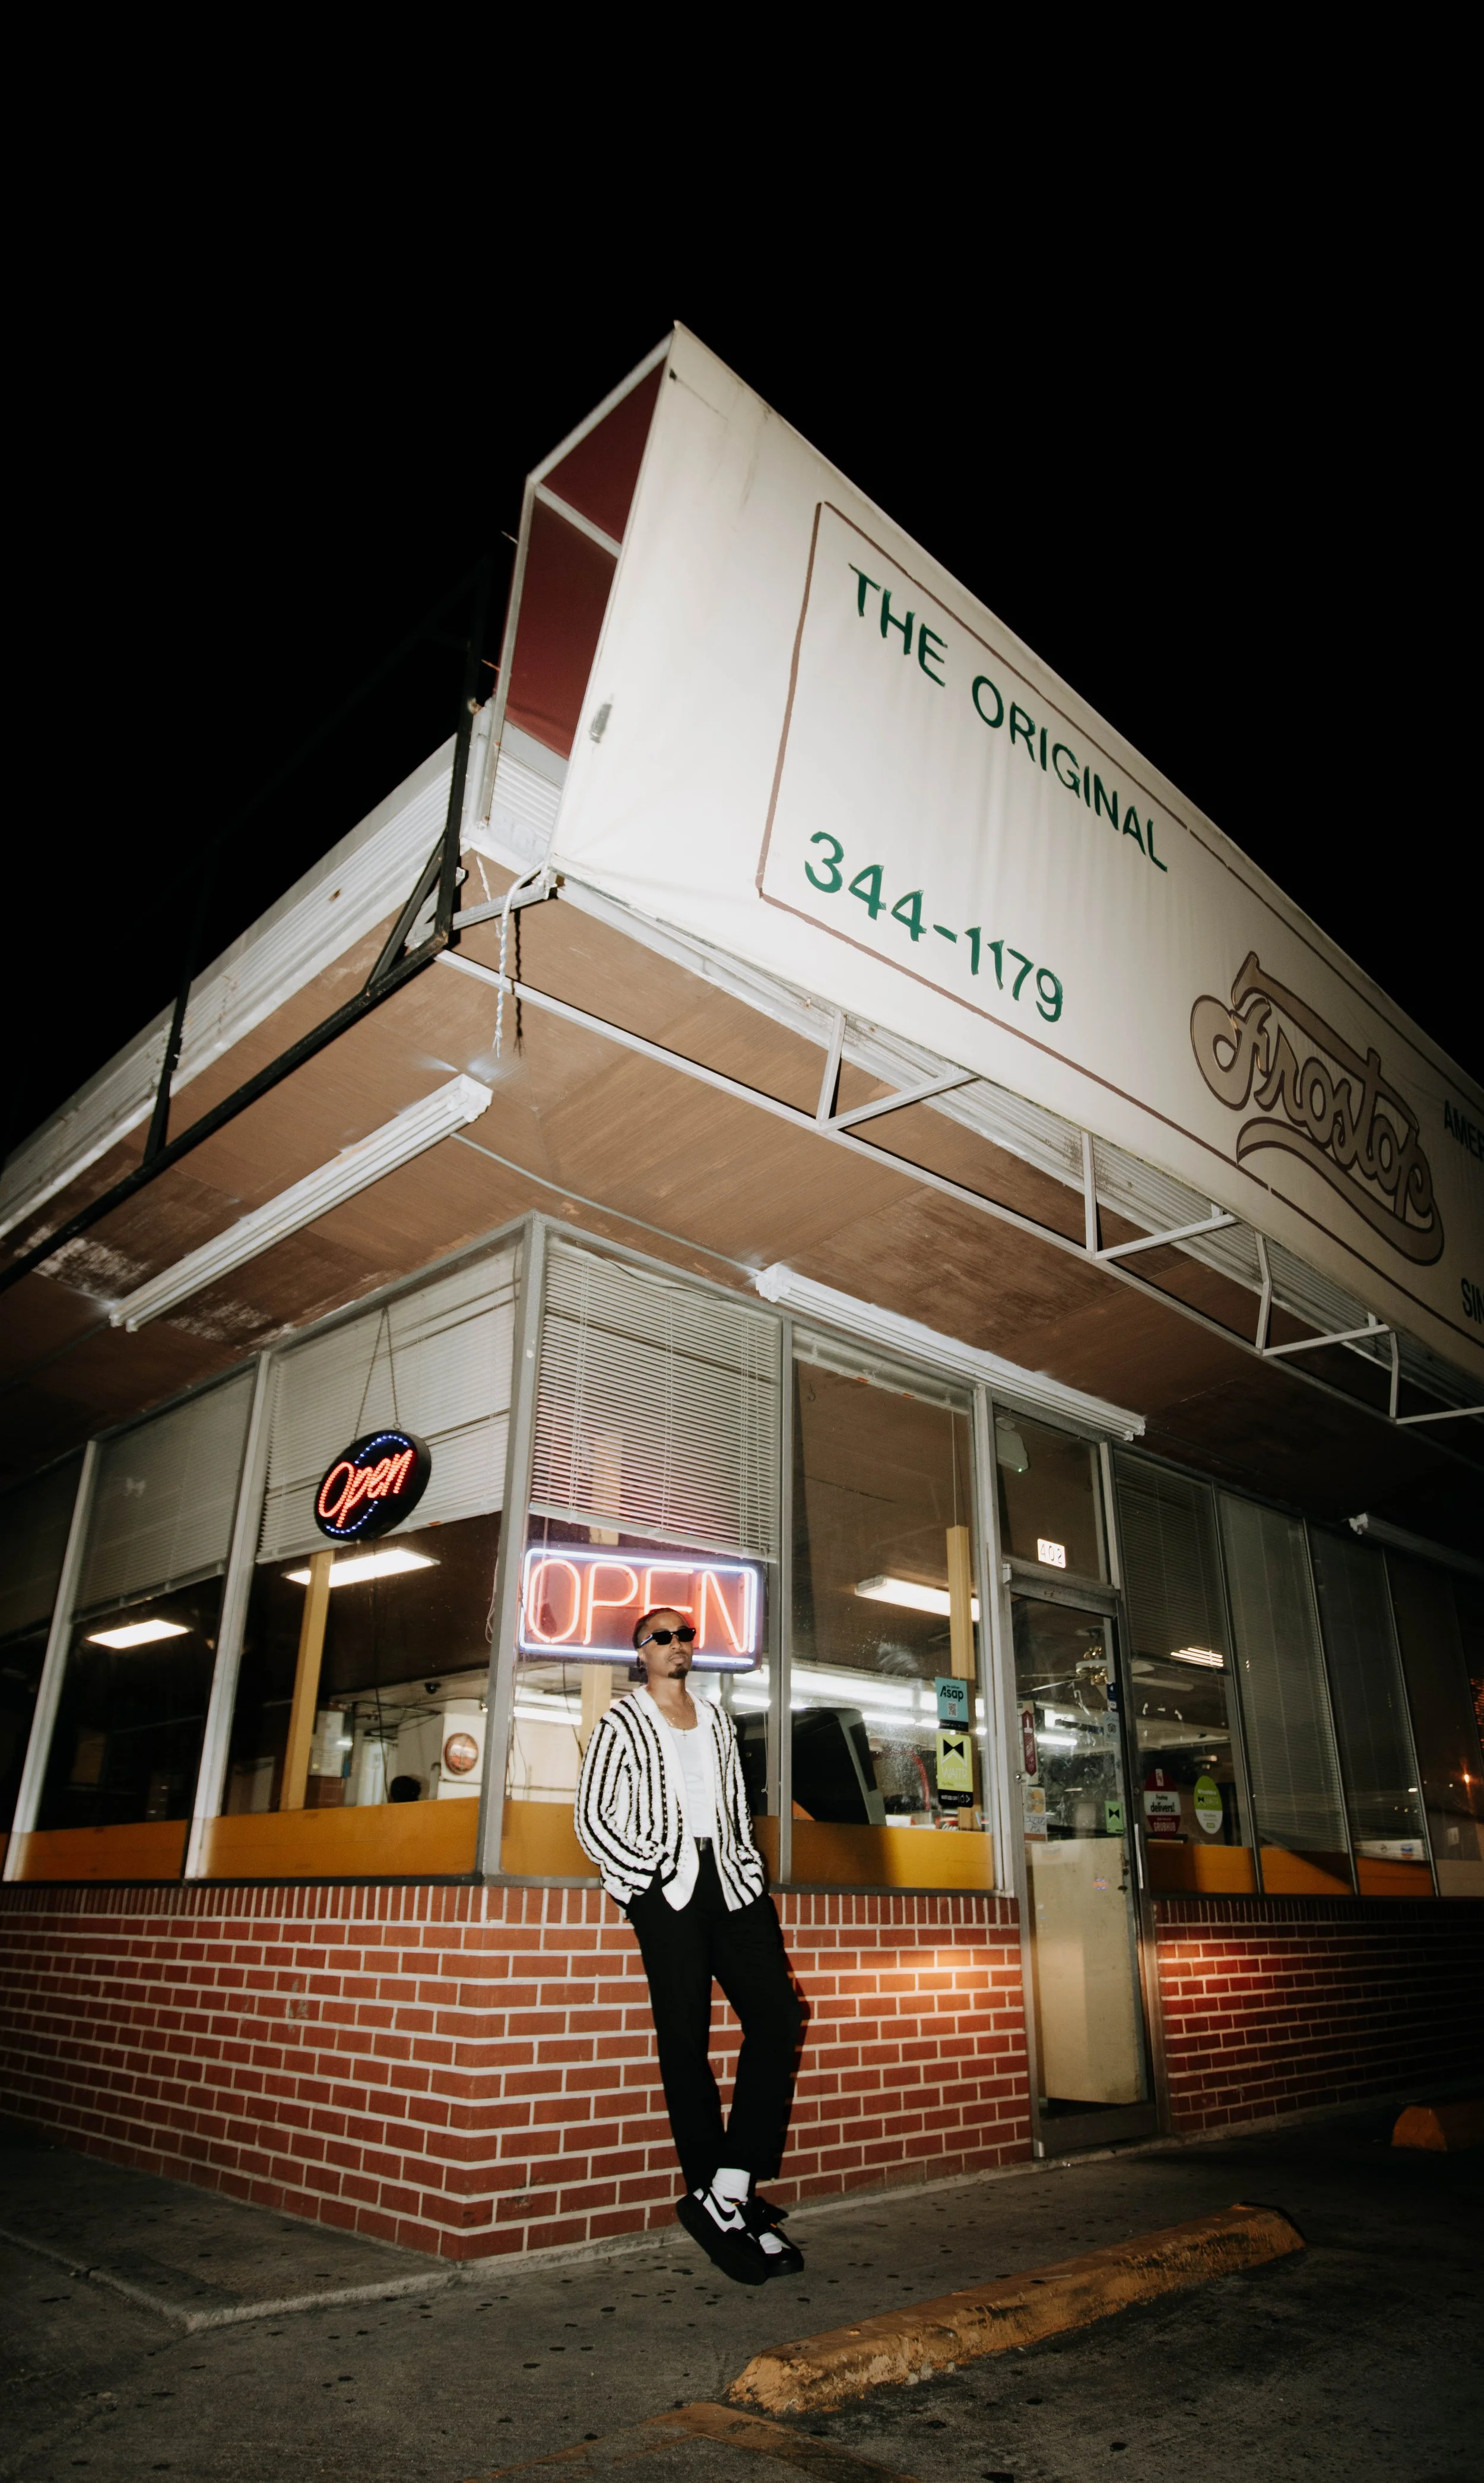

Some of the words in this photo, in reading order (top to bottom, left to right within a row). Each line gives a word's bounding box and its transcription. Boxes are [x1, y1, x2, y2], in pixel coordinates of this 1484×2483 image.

[848, 563, 947, 687] THE
[972, 675, 1168, 873] ORIGINAL
[804, 831, 1063, 1022] 344-1179
[1190, 951, 1437, 1226] Frostop
[318, 1449, 413, 1528] Open
[1040, 1543, 1063, 1564] 402
[527, 1558, 750, 1654] OPEN
[940, 1686, 964, 1702] Asap
[941, 1766, 968, 1781] WAITR
[1150, 1801, 1175, 1813] delivers!
